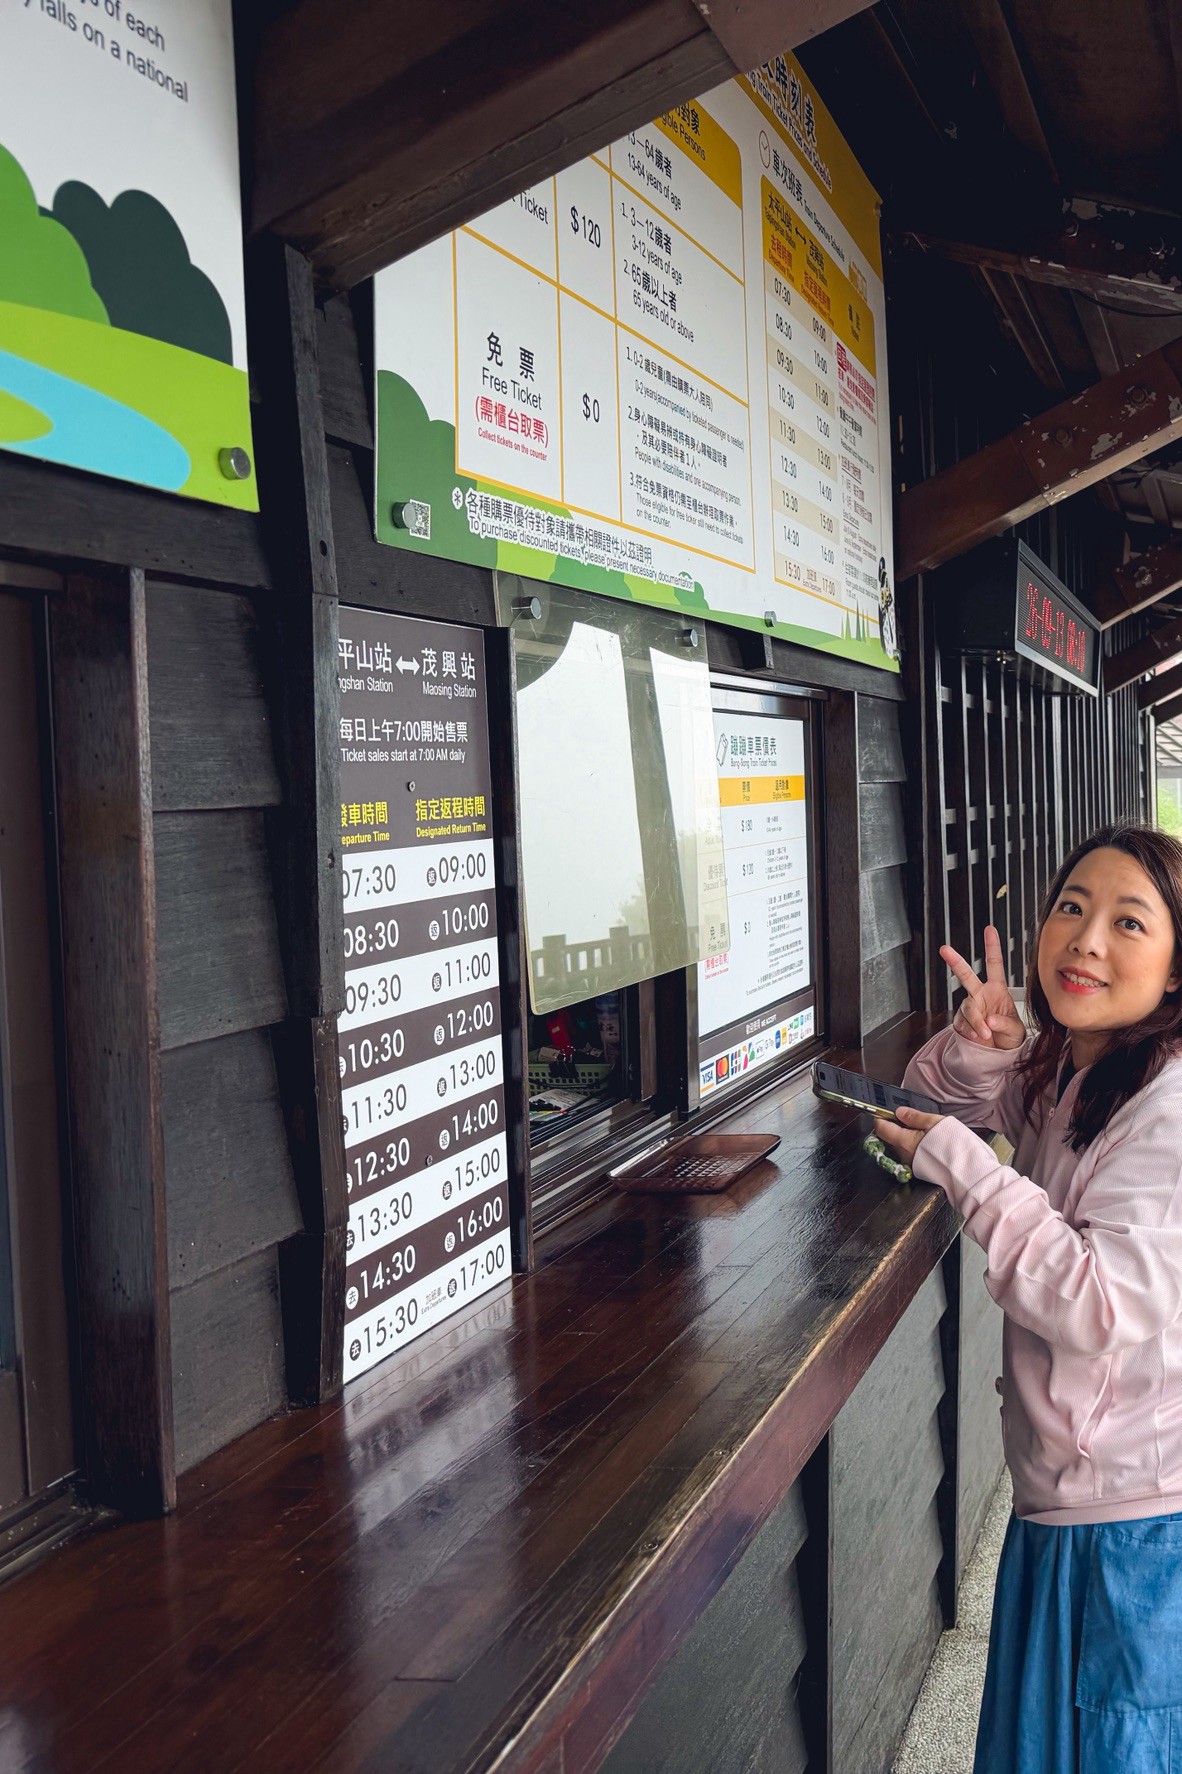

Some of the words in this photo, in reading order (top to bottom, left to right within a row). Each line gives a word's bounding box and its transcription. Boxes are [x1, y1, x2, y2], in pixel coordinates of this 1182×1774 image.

[104, 0, 120, 21] of
[126, 12, 165, 51] each
[83, 22, 105, 50] on
[110, 40, 121, 60] a
[126, 50, 189, 103] national
[772, 92, 787, 126] Ticket
[680, 124, 706, 160] Persons
[627, 153, 645, 179] 13-64
[645, 170, 662, 194] years
[664, 185, 670, 200] of
[671, 190, 681, 210] age
[520, 191, 548, 225] Ticket
[632, 235, 646, 258] 3-12
[647, 249, 663, 270] years
[664, 261, 670, 275] of
[672, 267, 682, 285] age
[632, 264, 676, 312] 65歲以上者
[774, 278, 791, 306] 07:30
[812, 317, 826, 342] 09:00
[633, 289, 641, 307] 65
[642, 297, 659, 319] years
[660, 309, 669, 326] old
[670, 317, 676, 330] or
[677, 320, 694, 342] above
[487, 332, 534, 382] 免票
[776, 314, 792, 340] 08:30
[814, 350, 827, 374] 10:00
[482, 367, 508, 394] Free
[511, 380, 542, 410] Ticket
[777, 349, 793, 375] 09:30
[815, 383, 828, 406] 11:00
[779, 384, 794, 410] 10:30
[475, 396, 549, 448] (需櫃台取票)
[478, 427, 496, 442] Collect
[497, 434, 513, 448] tickets
[514, 442, 520, 451] on
[521, 443, 529, 455] the
[530, 449, 547, 461] counter
[780, 420, 795, 444] 11:30
[635, 445, 651, 466] People
[781, 455, 797, 478] 12:30
[819, 481, 832, 502] 14:00
[636, 492, 651, 508] Those
[783, 491, 799, 513] 13:30
[820, 513, 833, 533] 15:00
[470, 516, 479, 530] To
[482, 520, 518, 541] purchase
[520, 531, 558, 552] discounted
[584, 548, 605, 564] please
[606, 556, 628, 572] present
[630, 563, 657, 582] necessary
[658, 570, 694, 590] documentation
[784, 526, 799, 547] 14:30
[821, 546, 834, 565] 16:00
[785, 560, 800, 581] 15:30
[822, 578, 835, 596] 17:00
[338, 638, 392, 673] 平山站
[421, 647, 476, 681] 茂興站
[367, 676, 394, 693] Station
[422, 681, 453, 699] Maosing
[453, 683, 477, 698] Station
[340, 718, 468, 743] 每日上午7:00開始售票
[341, 748, 366, 762] Ticket
[368, 748, 389, 761] sales
[391, 749, 408, 761] start
[409, 749, 418, 761] at
[419, 748, 435, 761] 7:00
[436, 749, 448, 761] AM
[449, 748, 466, 764] daily
[415, 795, 486, 822] 指定返程時間
[342, 832, 372, 847] eparture
[373, 831, 390, 842] Time
[416, 825, 450, 838] Designated
[452, 823, 472, 834] Return
[472, 822, 486, 832] Time
[343, 864, 396, 899] 07:30
[439, 852, 486, 883] 09:00
[344, 919, 399, 957] 08:30
[442, 902, 489, 936] 10:00
[346, 974, 401, 1014] 09:30
[445, 952, 490, 987] 11:00
[348, 1029, 405, 1072] 10:30
[447, 1001, 493, 1039] 12:00
[352, 1084, 407, 1129] 11:30
[450, 1050, 495, 1089] 13:00
[702, 1070, 714, 1084] VISA
[354, 1138, 410, 1186] 12:30
[452, 1099, 498, 1141] 14:00
[358, 1192, 412, 1242] 13:30
[455, 1148, 500, 1191] 15:00
[360, 1245, 416, 1298] 14:30
[457, 1196, 502, 1242] 16:00
[364, 1298, 418, 1353] 15:30
[460, 1244, 504, 1291] 17:00
